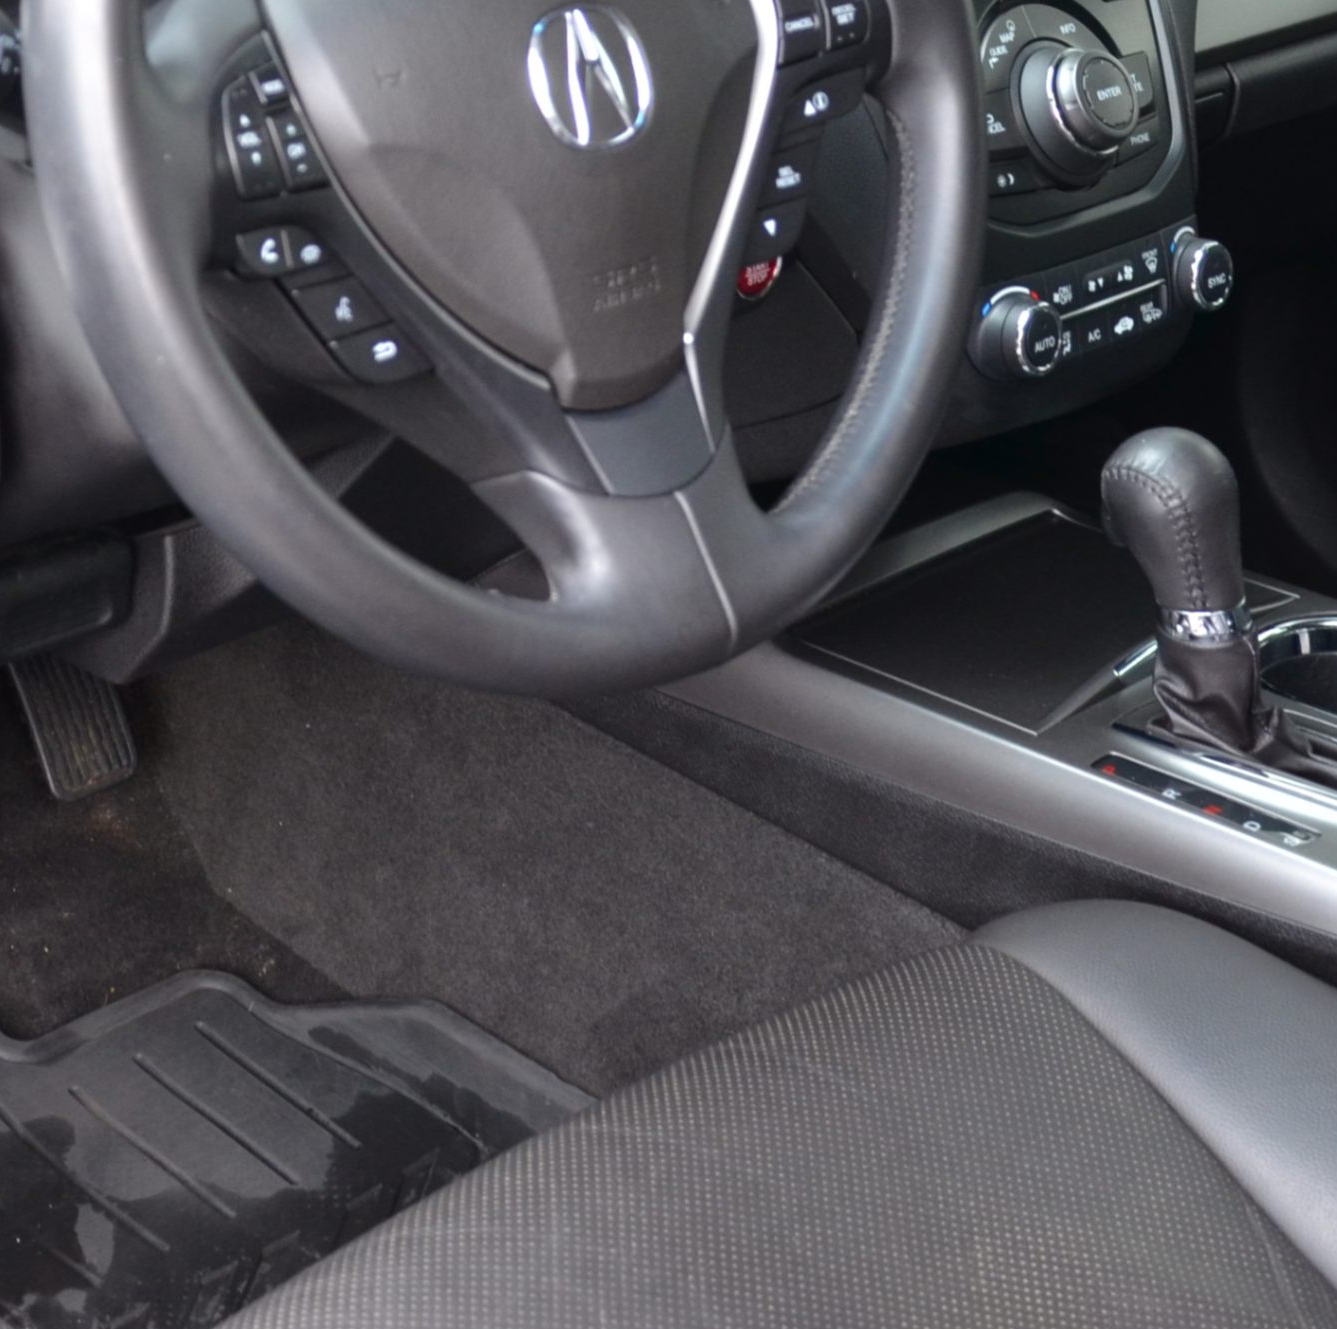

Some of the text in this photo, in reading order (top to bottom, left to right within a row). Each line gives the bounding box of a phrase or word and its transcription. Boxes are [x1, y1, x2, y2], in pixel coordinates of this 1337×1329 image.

[784, 16, 814, 33] CANCEL
[1060, 22, 1076, 35] INFO
[999, 30, 1015, 44] MAP
[989, 45, 1008, 57] GUIDE
[1097, 85, 1122, 101] ENTER
[1130, 132, 1150, 146] PHONE
[1207, 275, 1227, 289] SYNC
[1059, 291, 1073, 305] OFF
[1088, 329, 1101, 343] A/C
[1034, 336, 1055, 353] AUTO
[1162, 787, 1181, 800] R
[1242, 821, 1262, 832] D
